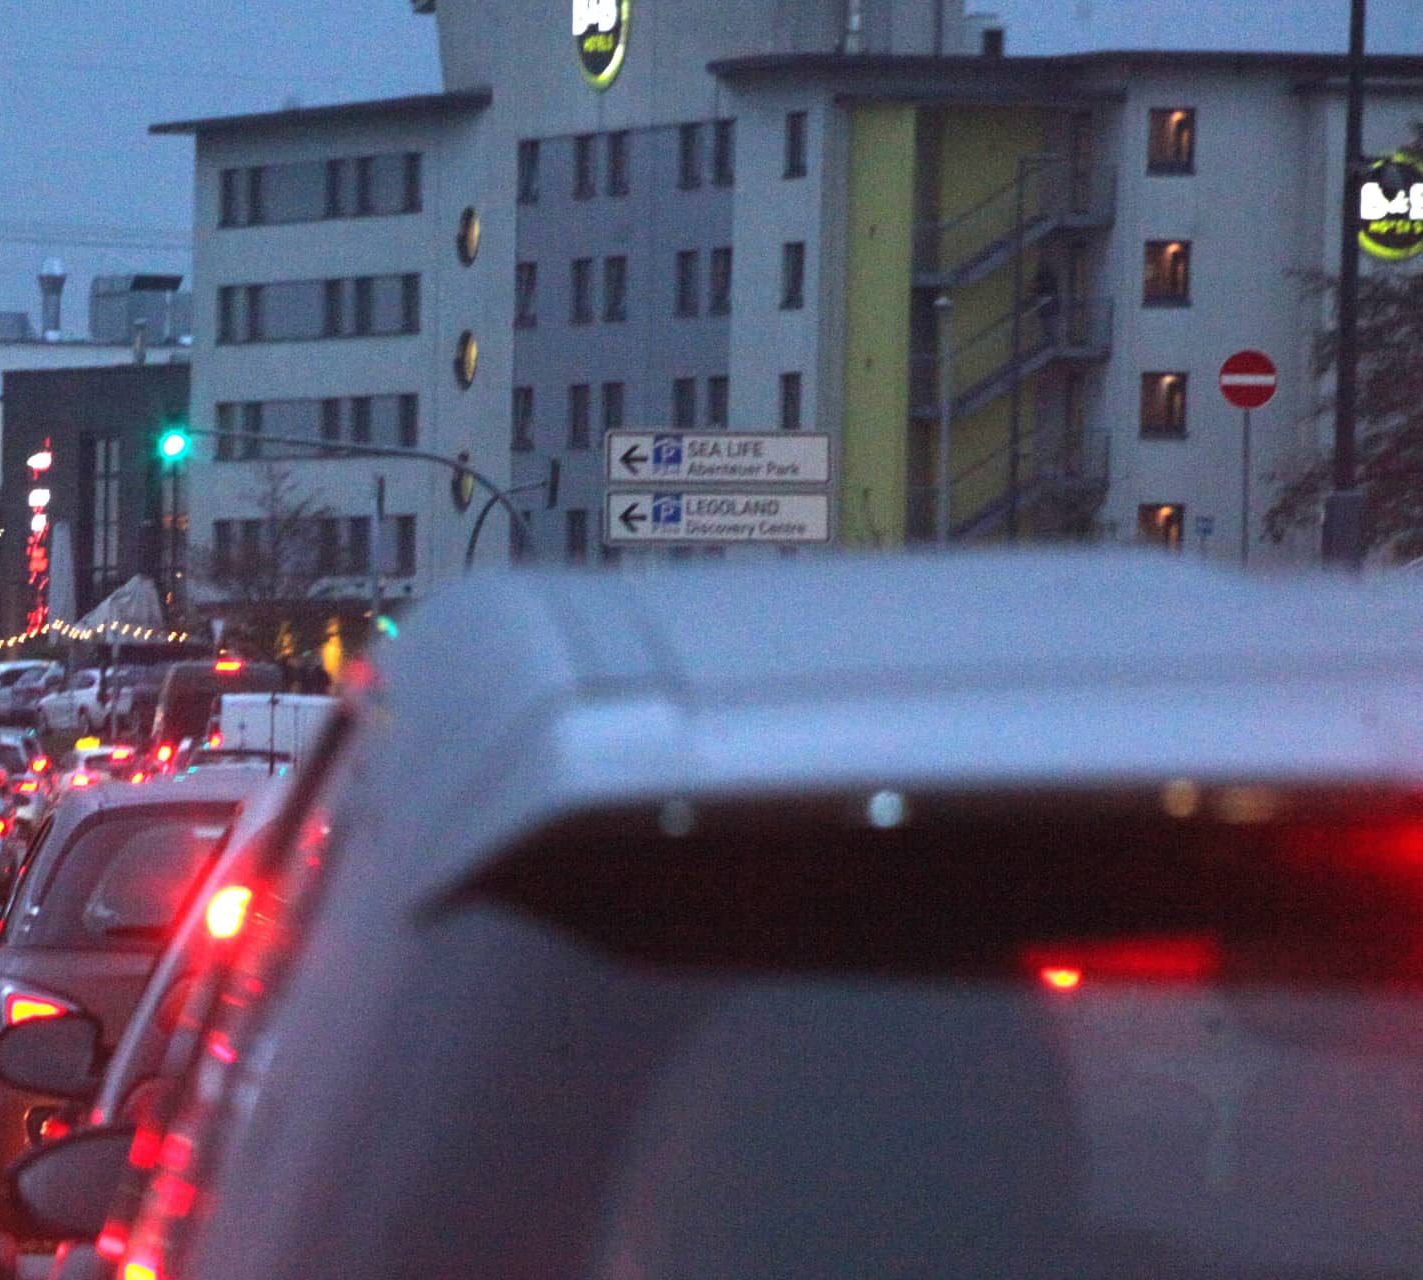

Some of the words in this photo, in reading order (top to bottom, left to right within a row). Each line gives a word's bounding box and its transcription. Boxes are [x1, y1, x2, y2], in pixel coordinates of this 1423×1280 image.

[687, 440, 721, 457] SEA
[726, 440, 765, 457] LIFE
[686, 461, 762, 477] Abenteuer
[766, 460, 800, 475] Park
[685, 499, 780, 516] LEGOLAND
[685, 520, 755, 537] Discovery
